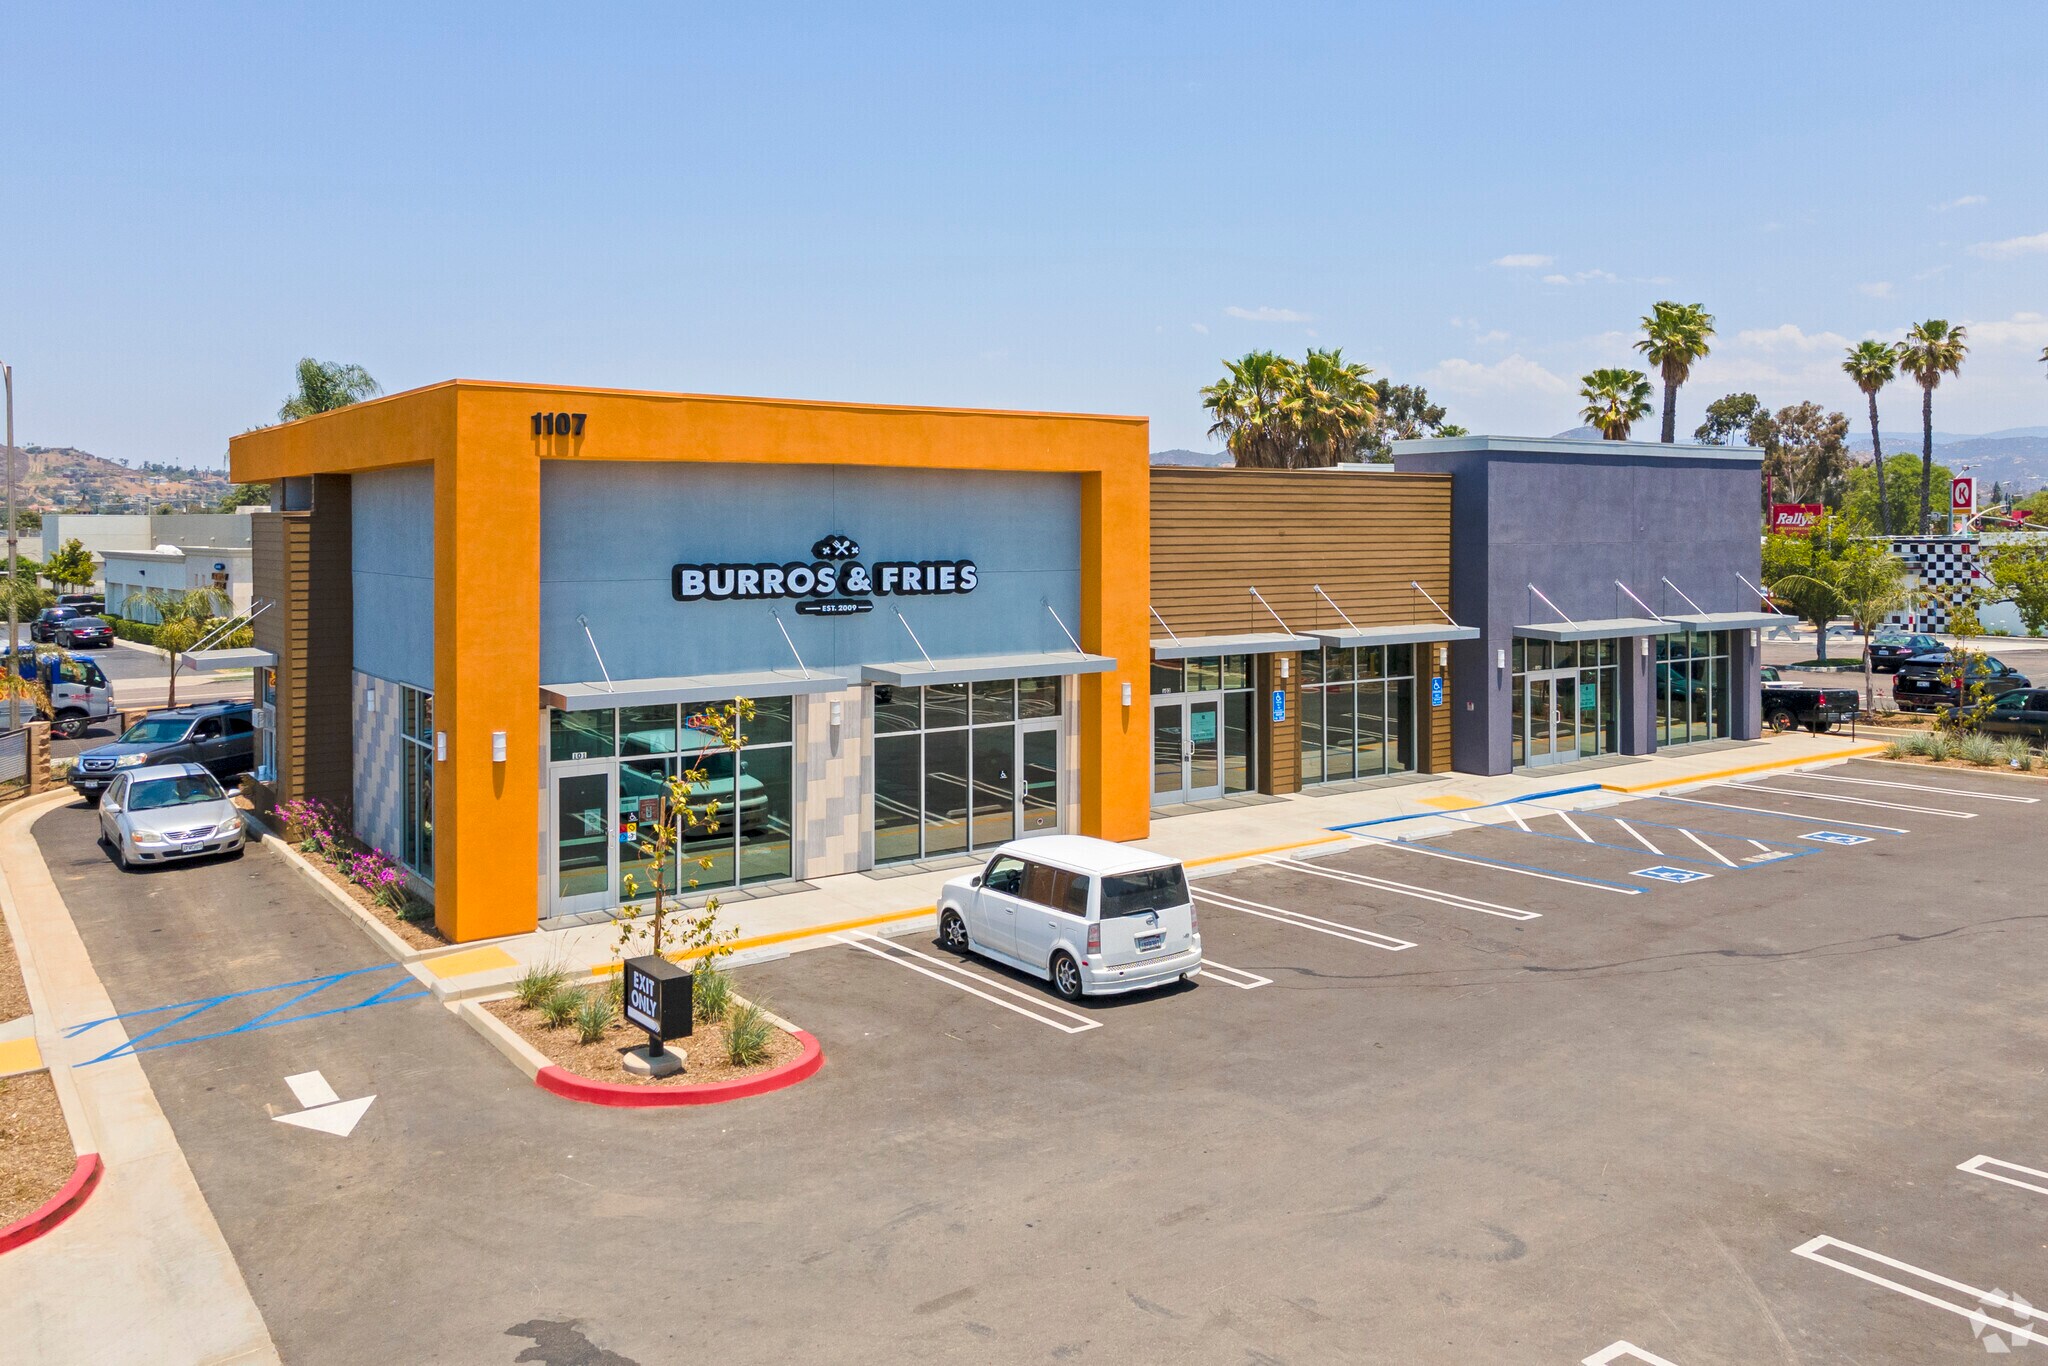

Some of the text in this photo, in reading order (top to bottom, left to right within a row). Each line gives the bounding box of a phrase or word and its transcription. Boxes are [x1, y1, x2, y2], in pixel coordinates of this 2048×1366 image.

[531, 412, 587, 435] 1107
[682, 565, 977, 595] BURROS & FRIES
[634, 971, 654, 996] EXIT
[632, 990, 656, 1017] ONLY
